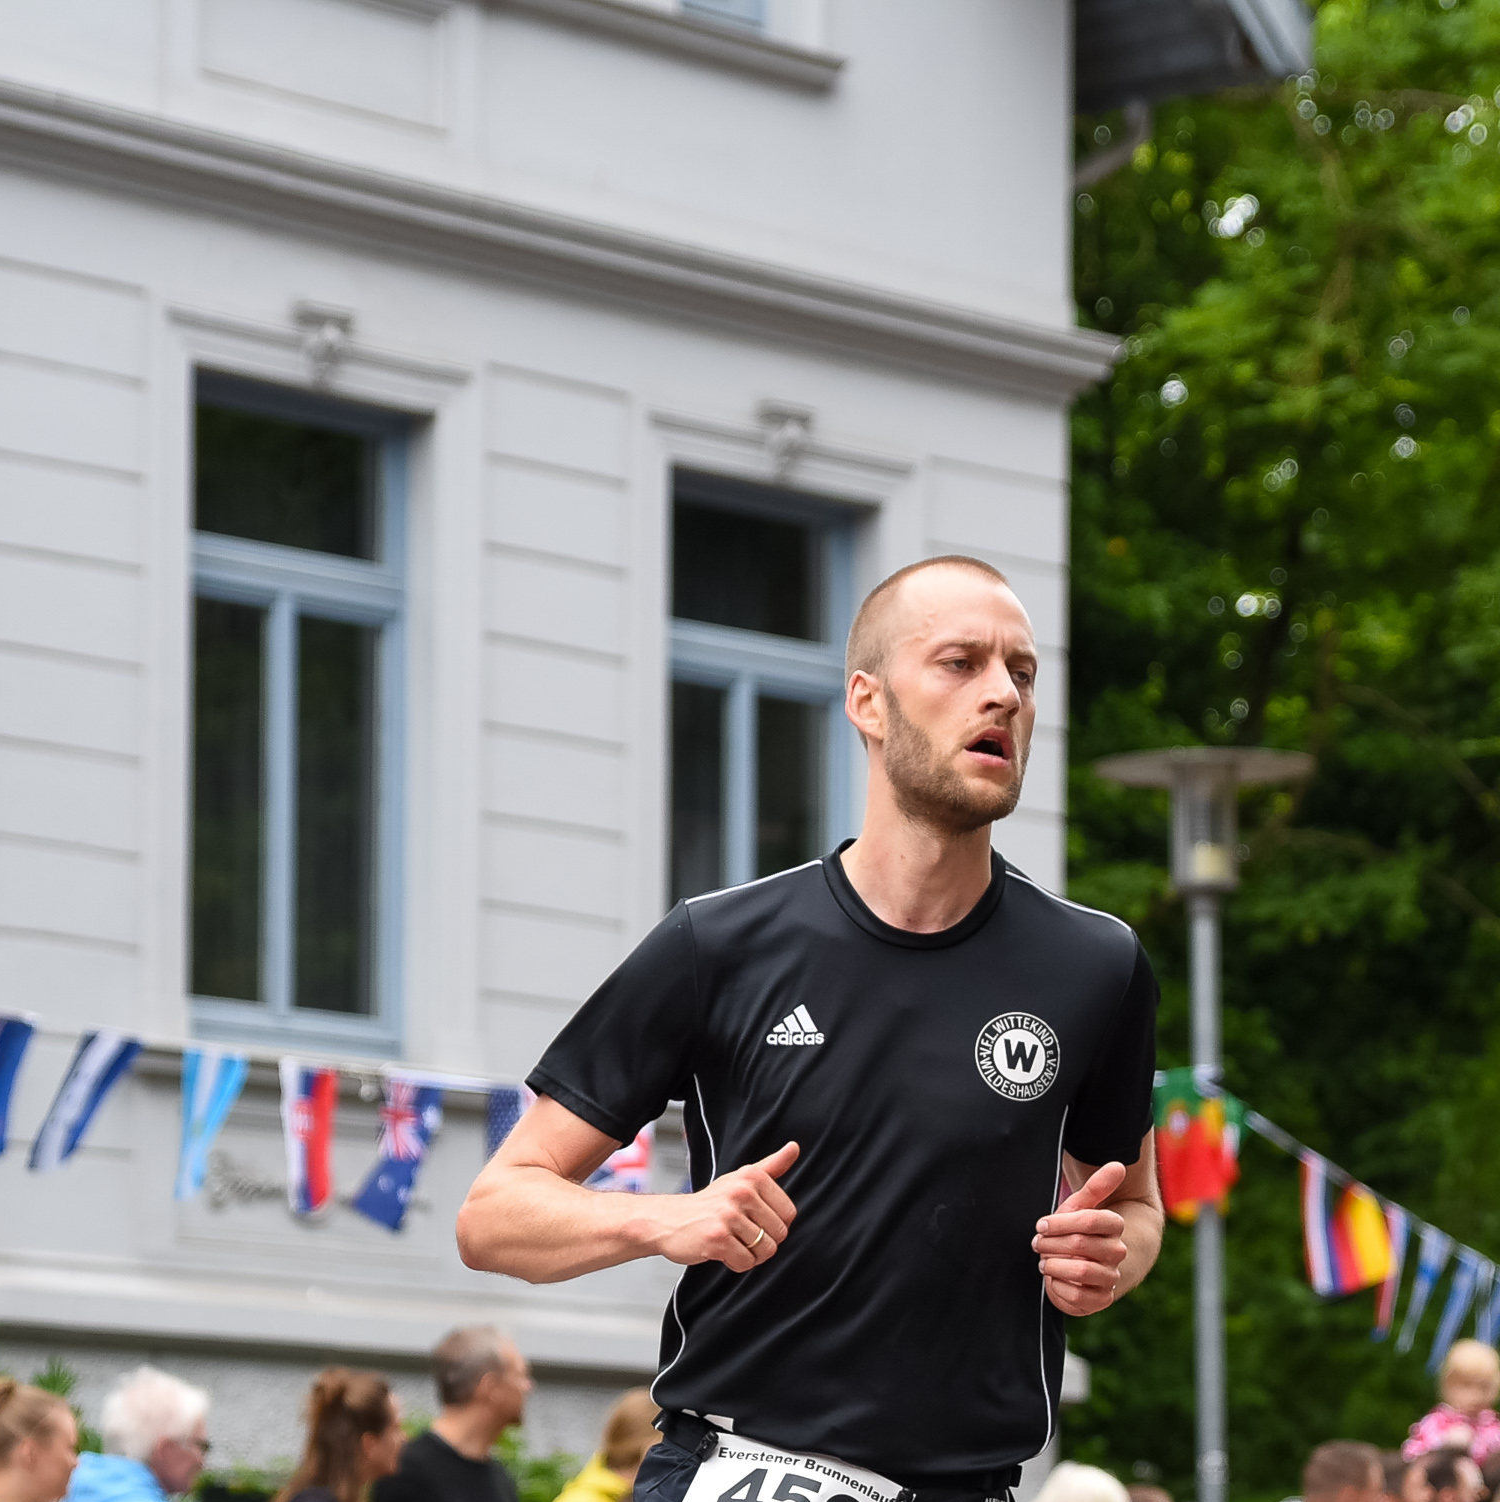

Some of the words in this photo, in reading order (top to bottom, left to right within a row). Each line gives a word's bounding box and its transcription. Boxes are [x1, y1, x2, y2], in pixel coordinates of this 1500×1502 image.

[766, 1030, 825, 1046] adidas
[992, 1016, 1054, 1047] WITTEKIND
[1003, 1038, 1039, 1073] W
[980, 1057, 1054, 1097] WILDESHAUSEN
[718, 1446, 800, 1467] Everstener
